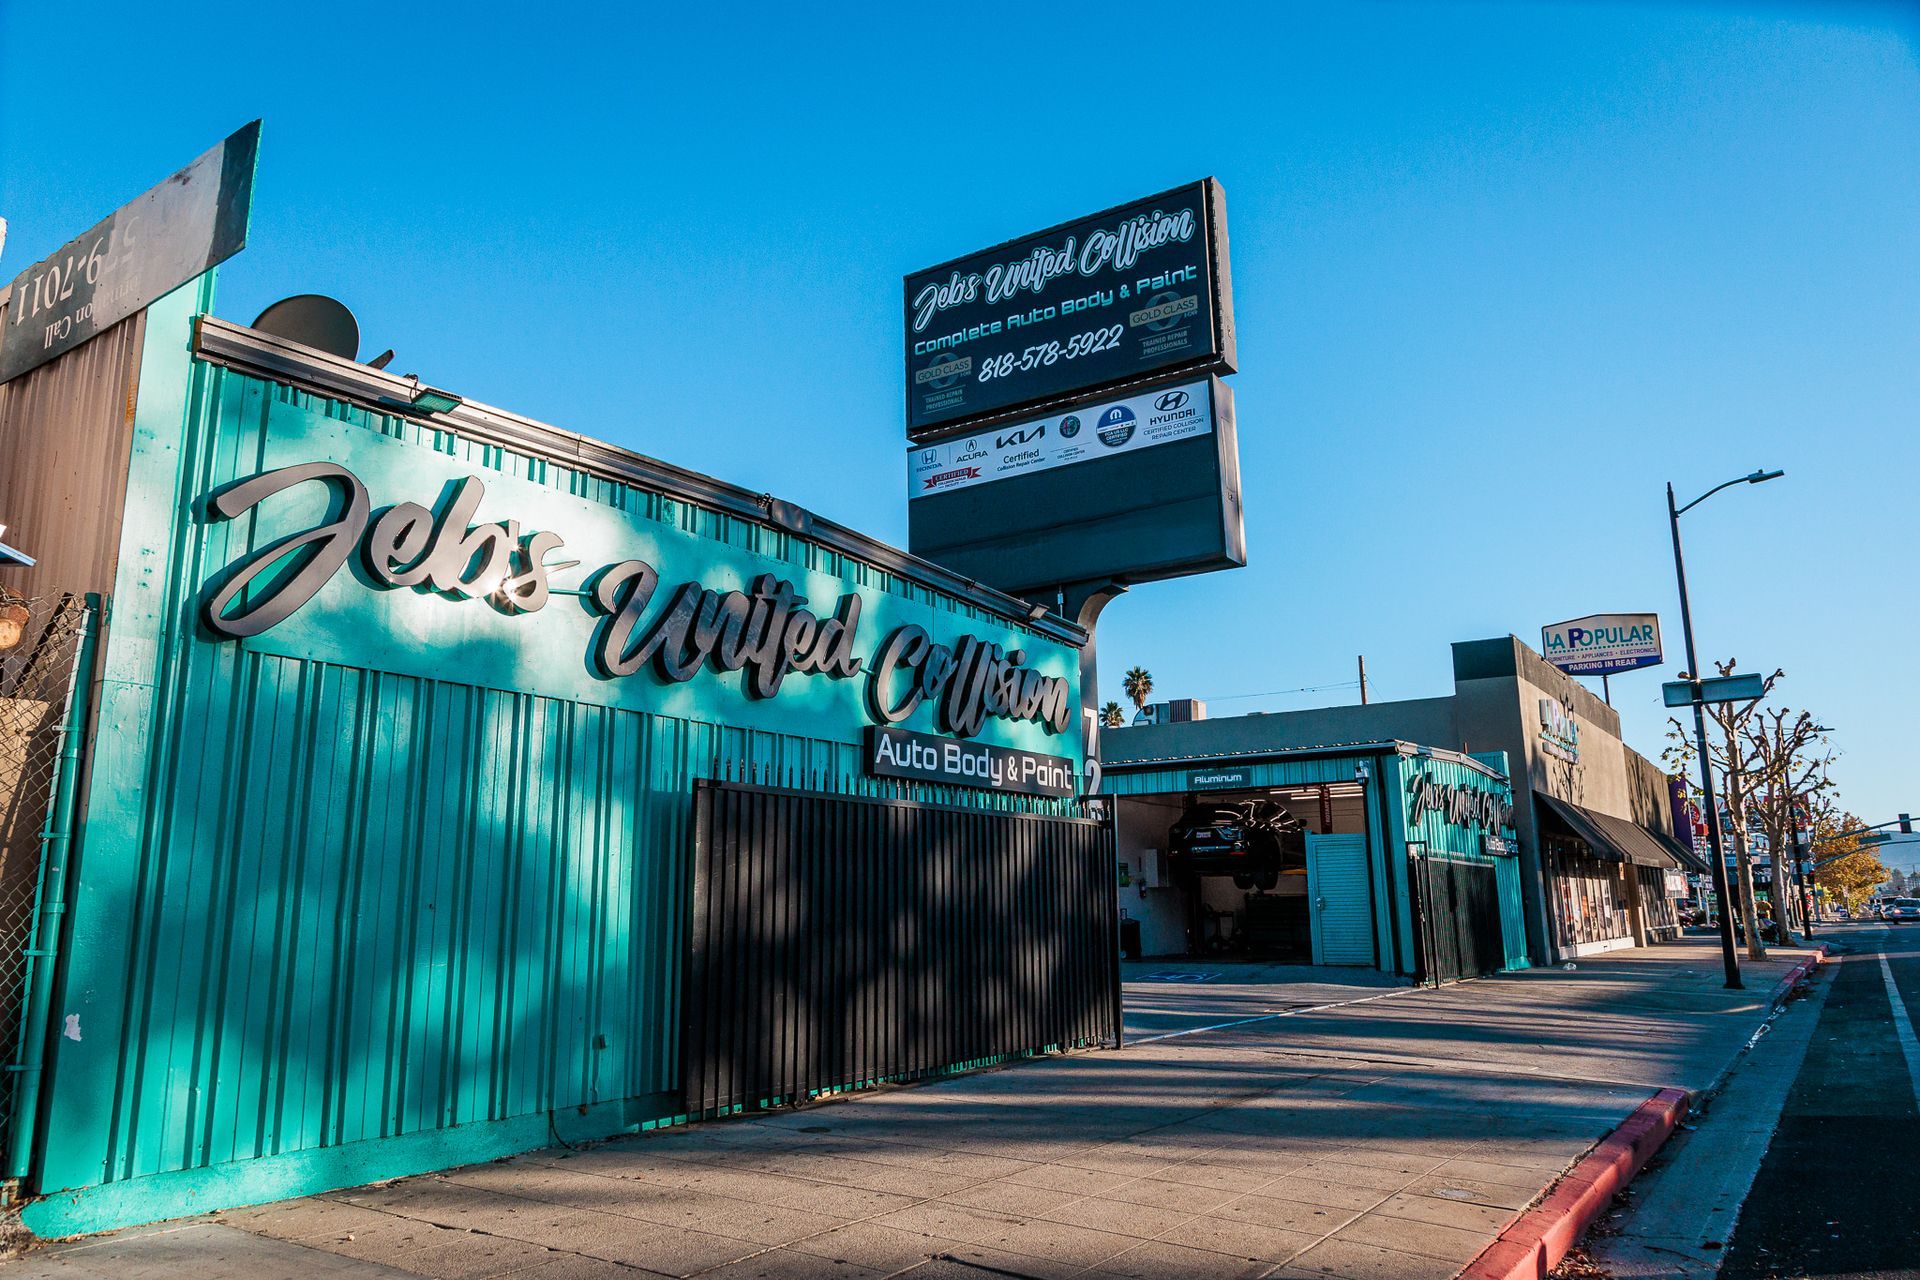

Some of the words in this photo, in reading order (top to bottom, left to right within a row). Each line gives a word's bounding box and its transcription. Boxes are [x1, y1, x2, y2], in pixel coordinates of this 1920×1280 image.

[985, 237, 1076, 303] United
[1080, 209, 1195, 275] Collision
[914, 321, 1002, 355] Complete
[1008, 306, 1055, 330] Auto
[1061, 289, 1113, 315] Body
[1120, 284, 1130, 298] &
[1136, 265, 1197, 294] Paint
[1132, 308, 1162, 324] GOLD
[1163, 299, 1195, 315] CLASS
[43, 315, 71, 350] Call
[1143, 336, 1166, 348] TRAINED
[1167, 330, 1188, 341] REPAIR
[978, 323, 1124, 382] 818-578-5922
[1143, 338, 1188, 355] PROFESSIONALS
[918, 369, 942, 381] GOLD
[943, 360, 969, 374] CLASS
[1150, 408, 1196, 425] HYUNDAI
[1143, 425, 1172, 435] CERTIFIED
[1173, 417, 1204, 429] COLLISION
[1151, 431, 1172, 440] REPAIR
[1173, 426, 1196, 435] CENTER
[956, 450, 988, 463] ACURA
[1003, 449, 1040, 464] Certified
[916, 462, 943, 473] HONDA
[935, 469, 969, 481] CERTIFIED
[1545, 631, 1566, 650] LA
[1567, 624, 1654, 648] POPULAR
[598, 560, 863, 699] United
[870, 624, 1071, 737] Collision
[1581, 651, 1614, 659] APPLIANCES
[1619, 647, 1657, 655] ELECTRONICS
[1568, 661, 1603, 671] PARKING
[1604, 660, 1614, 668] IN
[1615, 658, 1637, 667] REAR
[876, 733, 937, 770] Auto
[944, 743, 1003, 787] Body
[1007, 755, 1018, 782] &
[1022, 756, 1072, 789] Paint
[1194, 774, 1242, 784] Aluminum
